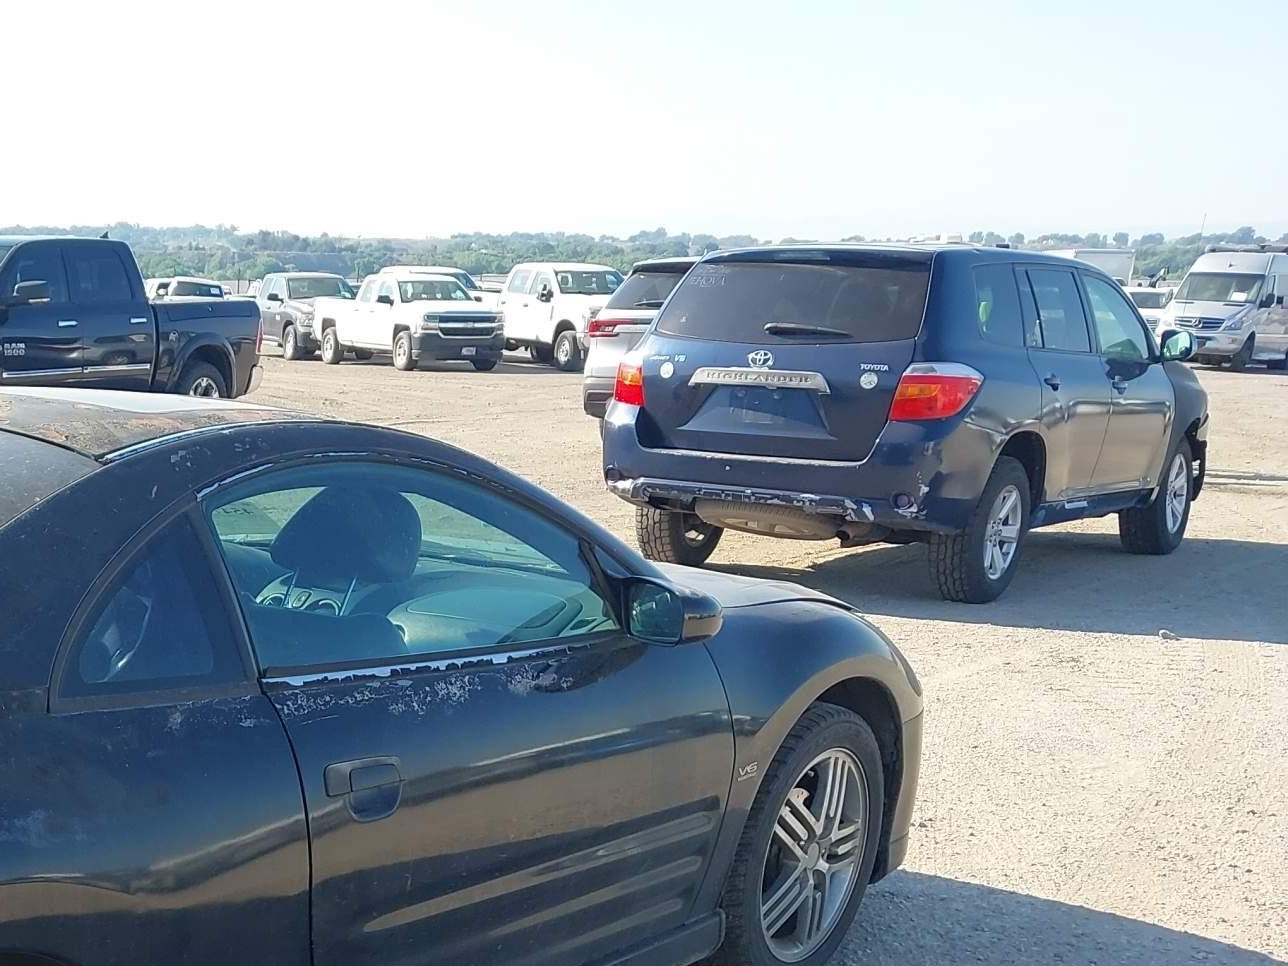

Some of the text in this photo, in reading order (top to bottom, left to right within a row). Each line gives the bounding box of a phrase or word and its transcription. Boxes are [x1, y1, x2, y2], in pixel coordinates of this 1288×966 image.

[859, 363, 889, 371] TOYOTA
[705, 370, 812, 384] HIGHLANDER
[738, 761, 758, 776] V6
